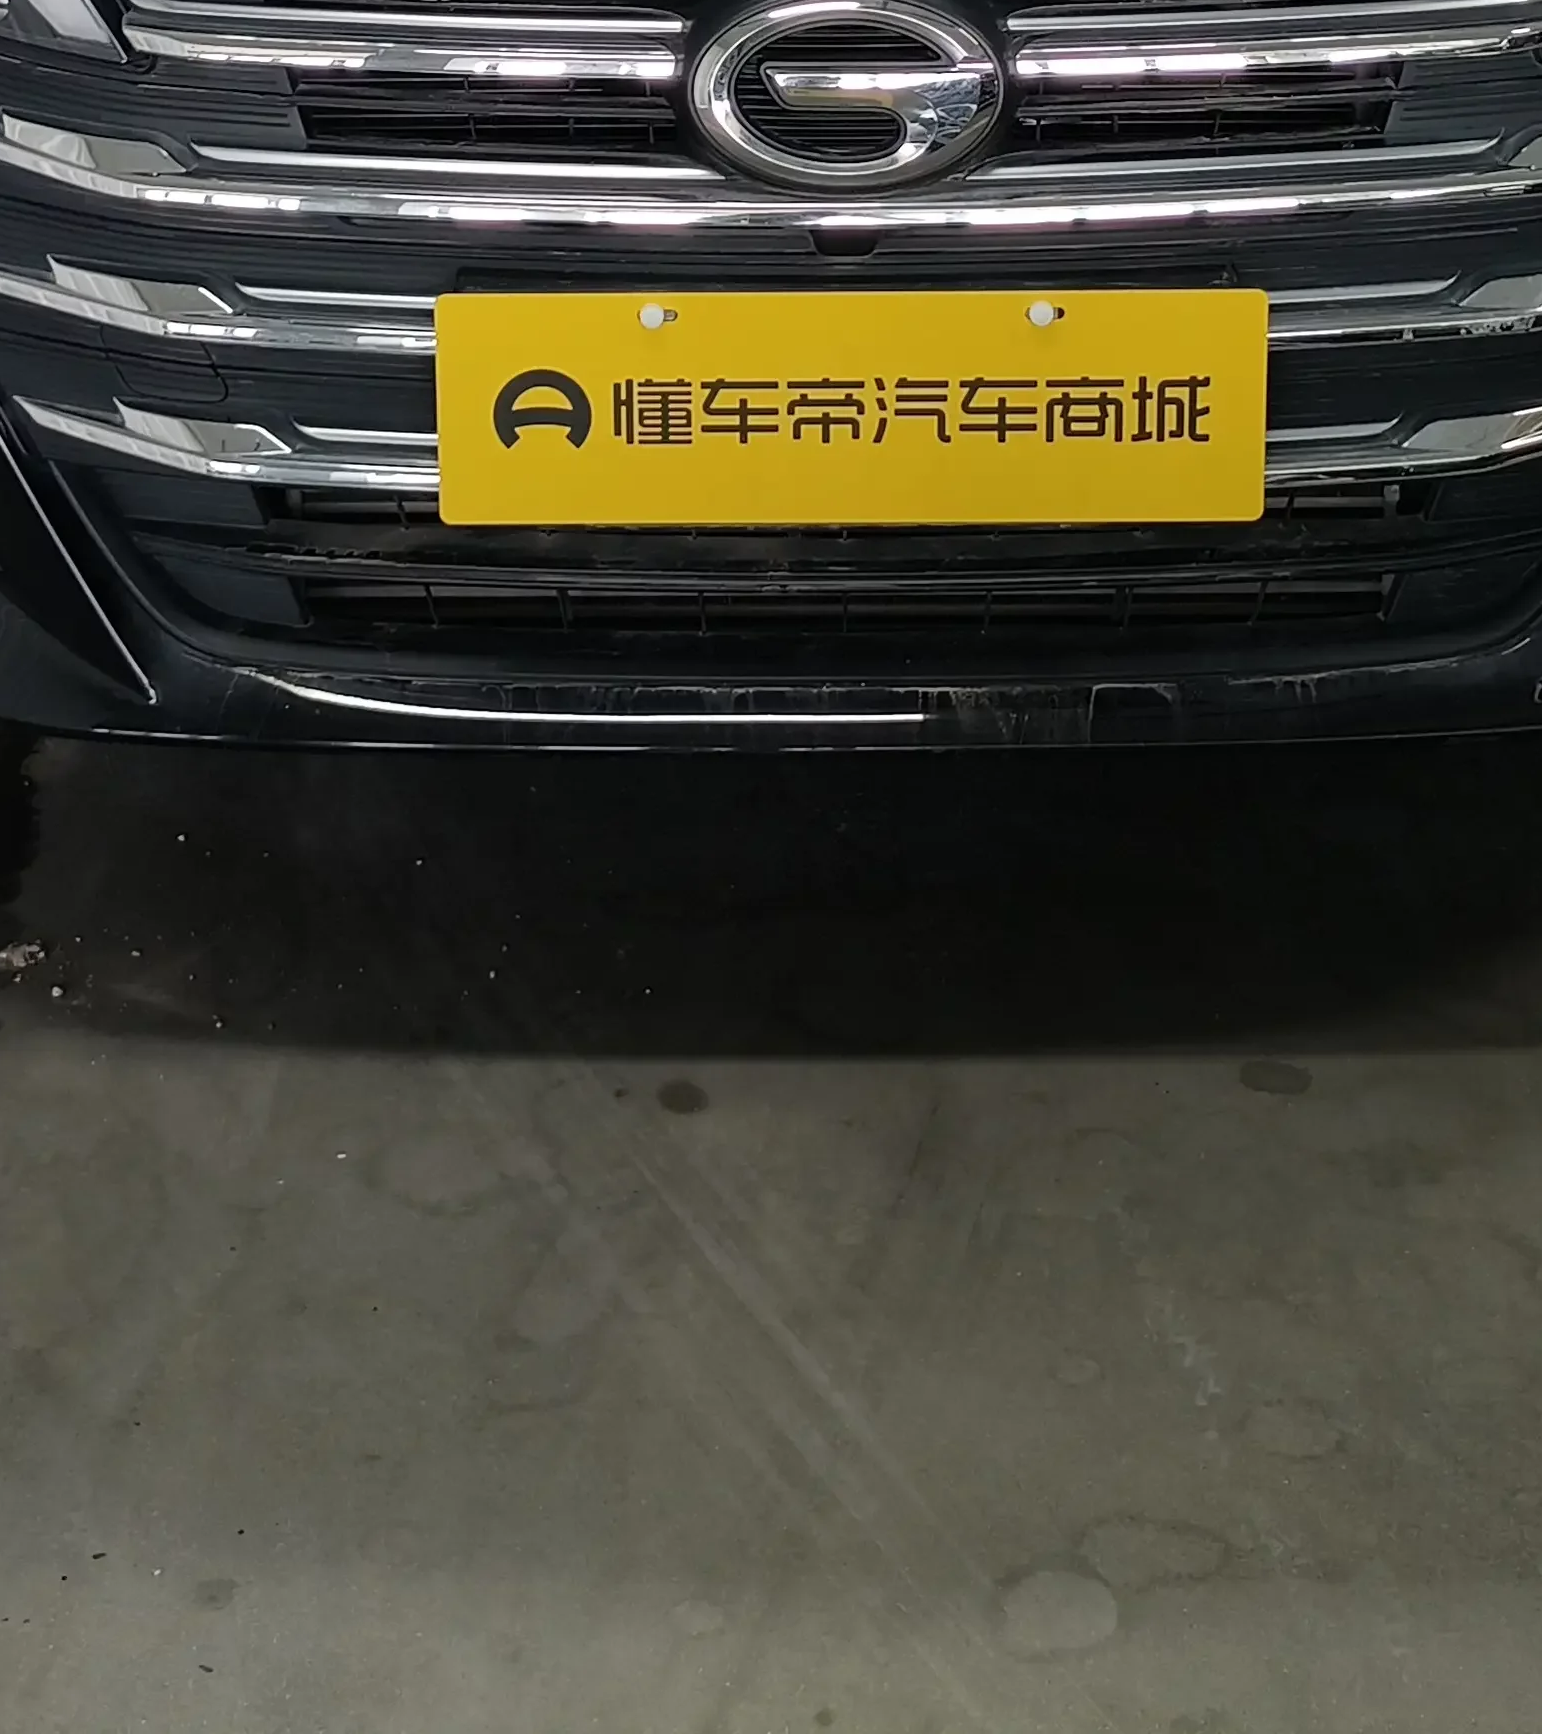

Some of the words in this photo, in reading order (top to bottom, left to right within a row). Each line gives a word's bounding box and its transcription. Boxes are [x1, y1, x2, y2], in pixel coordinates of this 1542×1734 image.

[612, 375, 1212, 446] 懂车帝汽车商城
